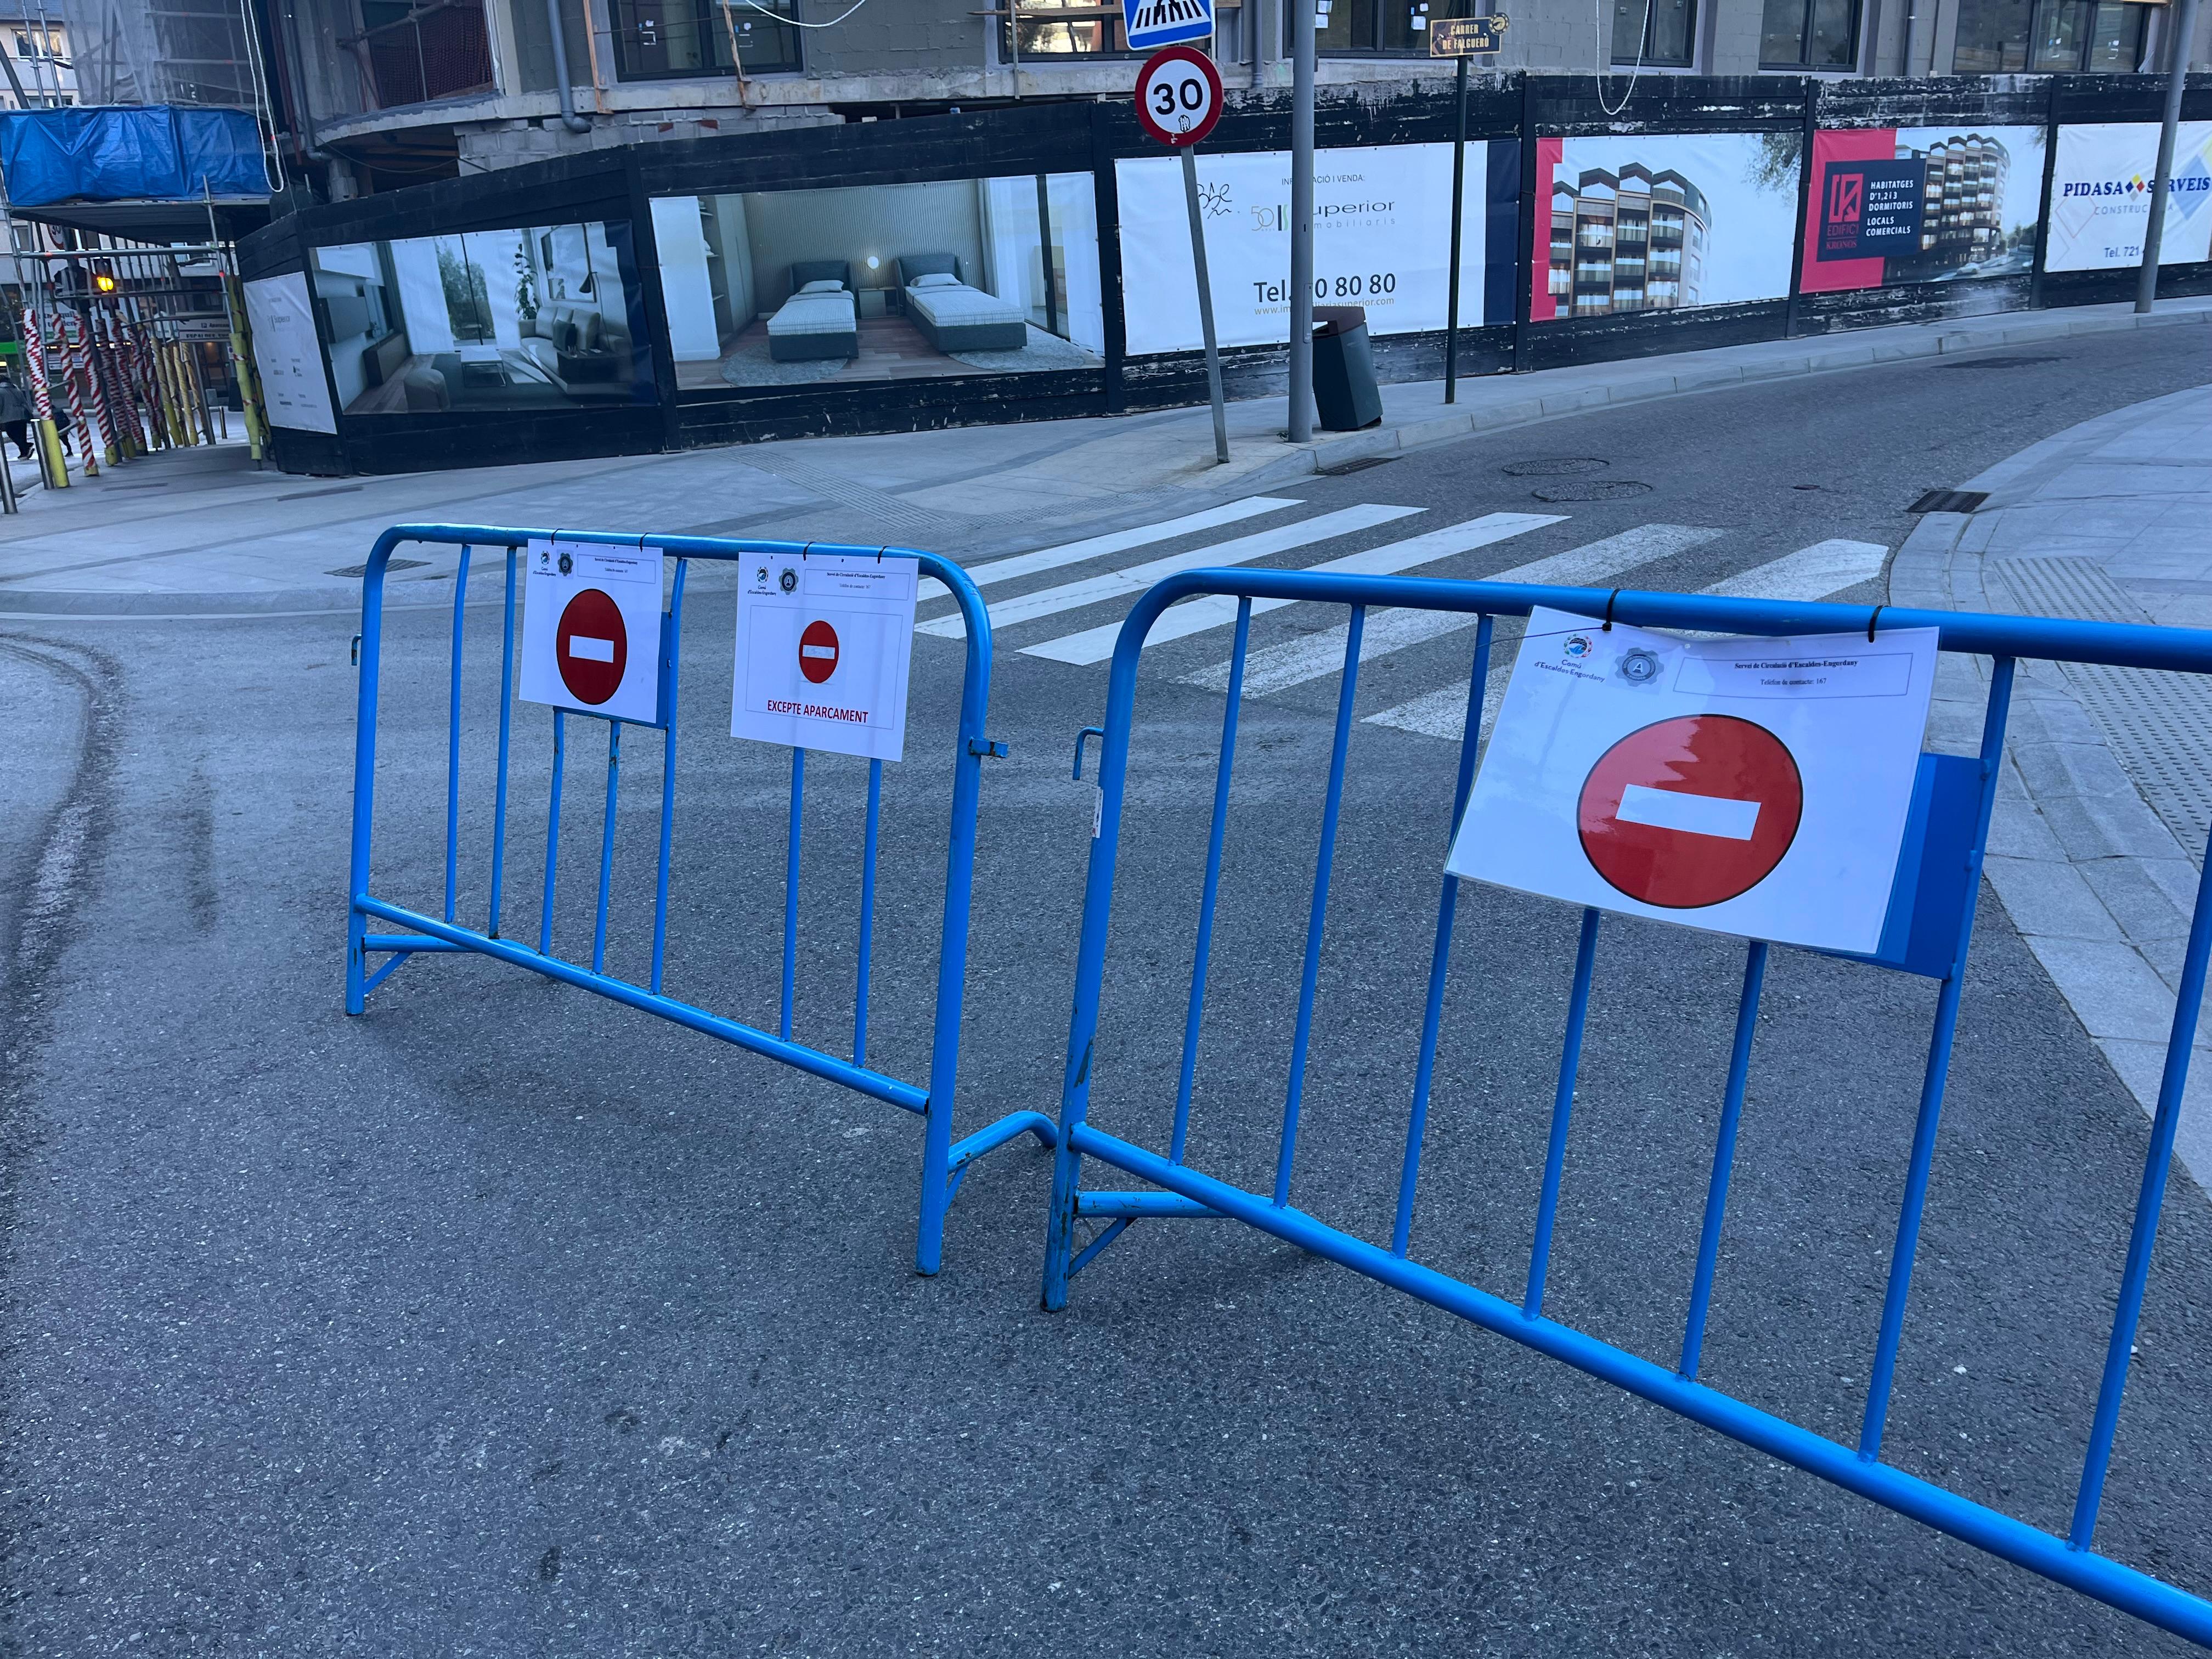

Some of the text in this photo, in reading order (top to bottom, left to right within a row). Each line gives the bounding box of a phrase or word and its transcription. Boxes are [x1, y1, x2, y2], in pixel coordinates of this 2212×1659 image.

[1450, 24, 1479, 36] CARRER
[1442, 40, 1452, 50] DE
[1153, 78, 1203, 115] 30
[1336, 174, 1365, 183] VENDA:
[1870, 179, 1914, 190] HABITATGES
[2063, 182, 2124, 196] PIDASA
[2147, 177, 2211, 193] SRVEIS
[1313, 200, 1395, 218] uperior
[1868, 201, 1914, 212] DORMITORIS
[1866, 216, 1895, 226] LOCALS
[1865, 225, 1911, 236] COMERCIALS
[2103, 246, 2140, 258] Tel. 721
[1335, 275, 1362, 297] 80
[1369, 273, 1396, 294] 80
[1561, 659, 1582, 669] Comú
[768, 699, 868, 723] EXCEPTE APARCAMENT
